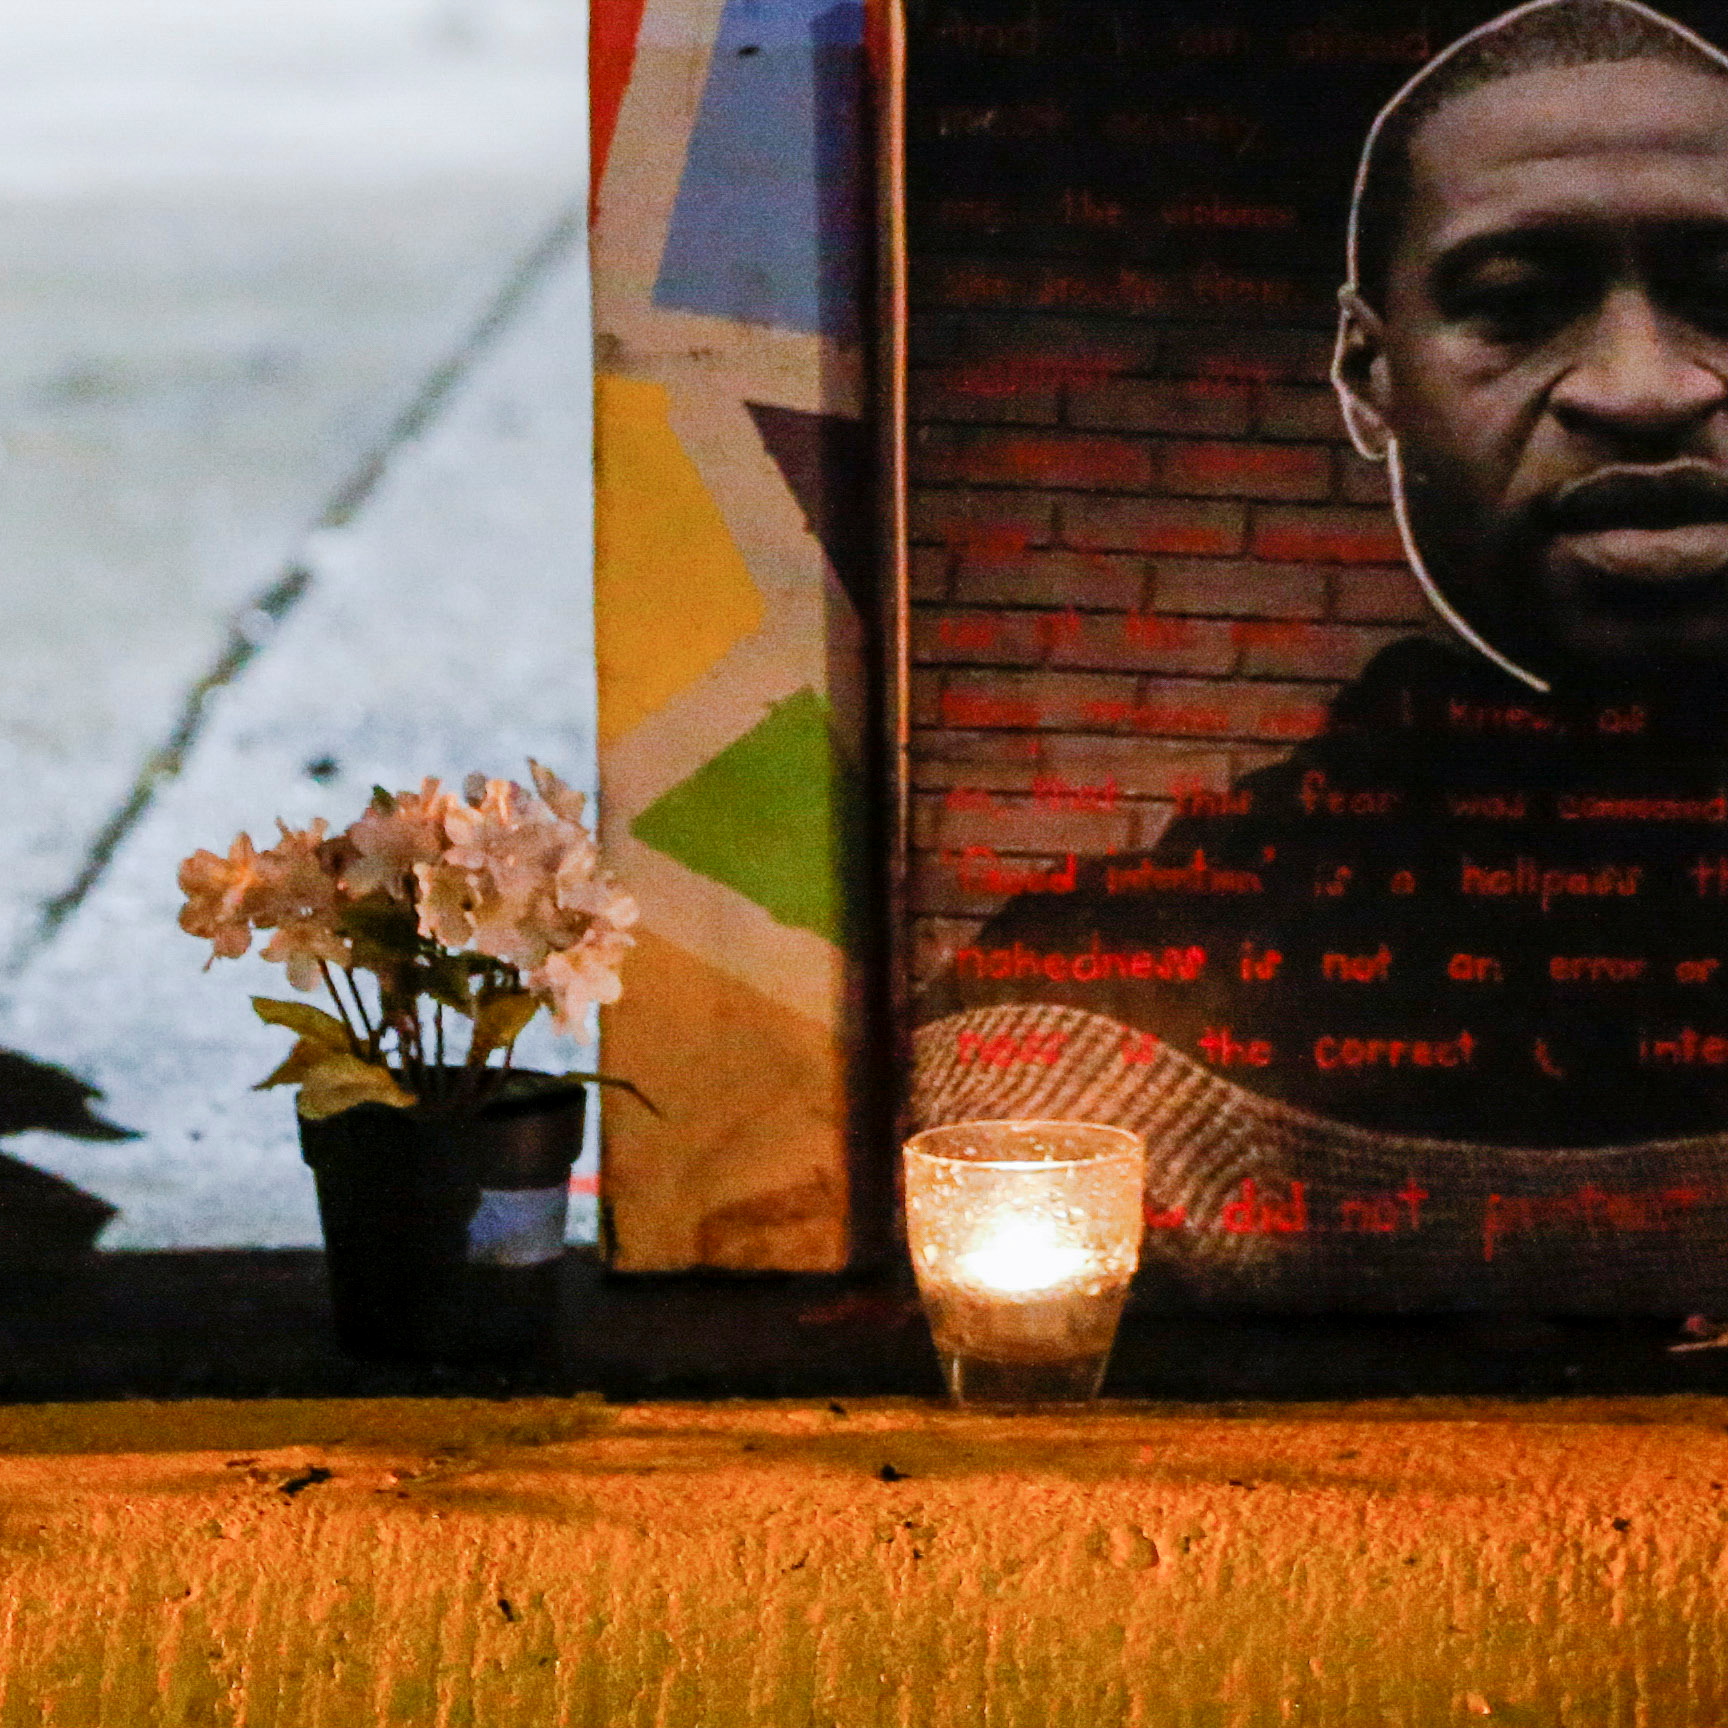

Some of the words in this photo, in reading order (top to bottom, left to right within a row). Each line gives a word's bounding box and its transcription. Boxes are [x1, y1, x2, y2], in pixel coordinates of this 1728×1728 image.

[1321, 941, 1394, 984] not
[1675, 957, 1721, 985] or
[1197, 1025, 1273, 1069] the
[1313, 1029, 1477, 1072] correct
[1222, 1177, 1309, 1235] did
[1340, 1177, 1430, 1234] not
